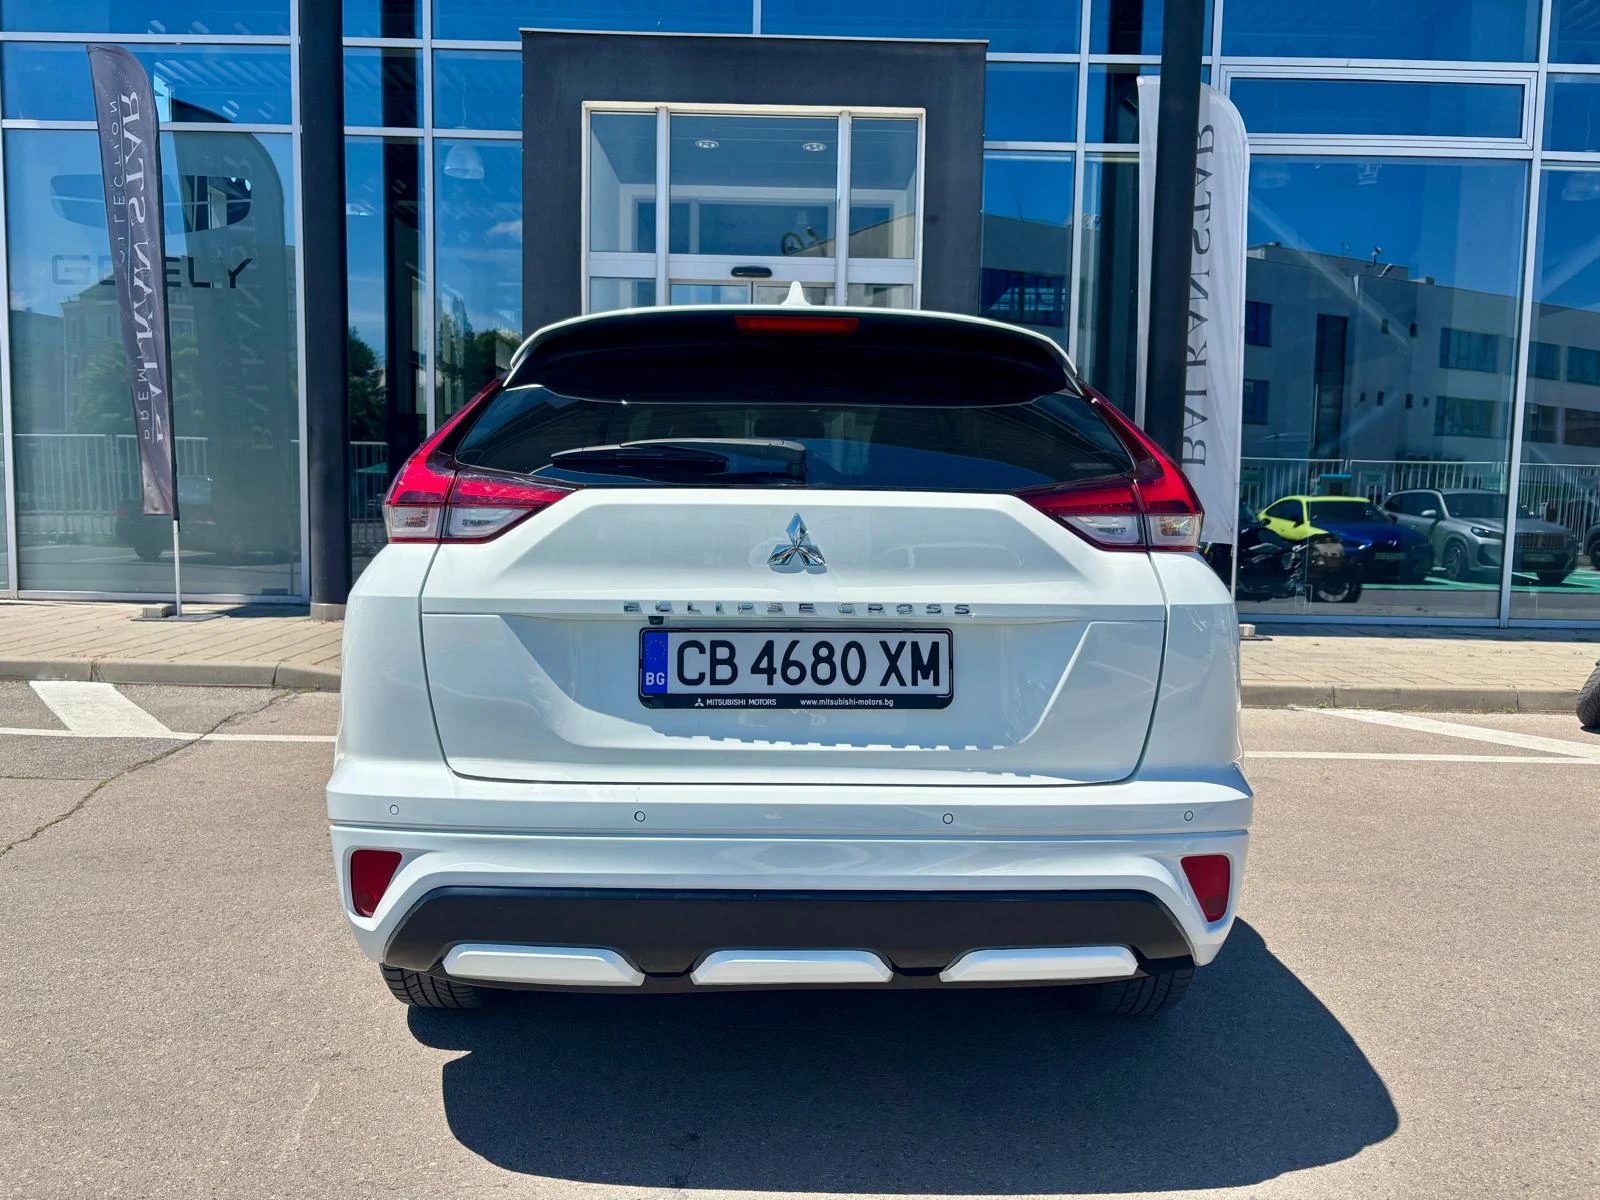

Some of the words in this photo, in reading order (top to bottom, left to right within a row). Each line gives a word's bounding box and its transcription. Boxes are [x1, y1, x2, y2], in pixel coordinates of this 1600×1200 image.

[623, 601, 815, 614] ECLIPSE
[839, 603, 970, 615] CROSS
[676, 640, 738, 686] CB
[750, 640, 867, 687] 4680
[879, 640, 941, 687] XM
[645, 671, 666, 686] BG
[706, 698, 746, 706] MITSUBISHI
[748, 698, 777, 706] MOTORS
[799, 698, 894, 708] www.mitsubishi-motors.bg
